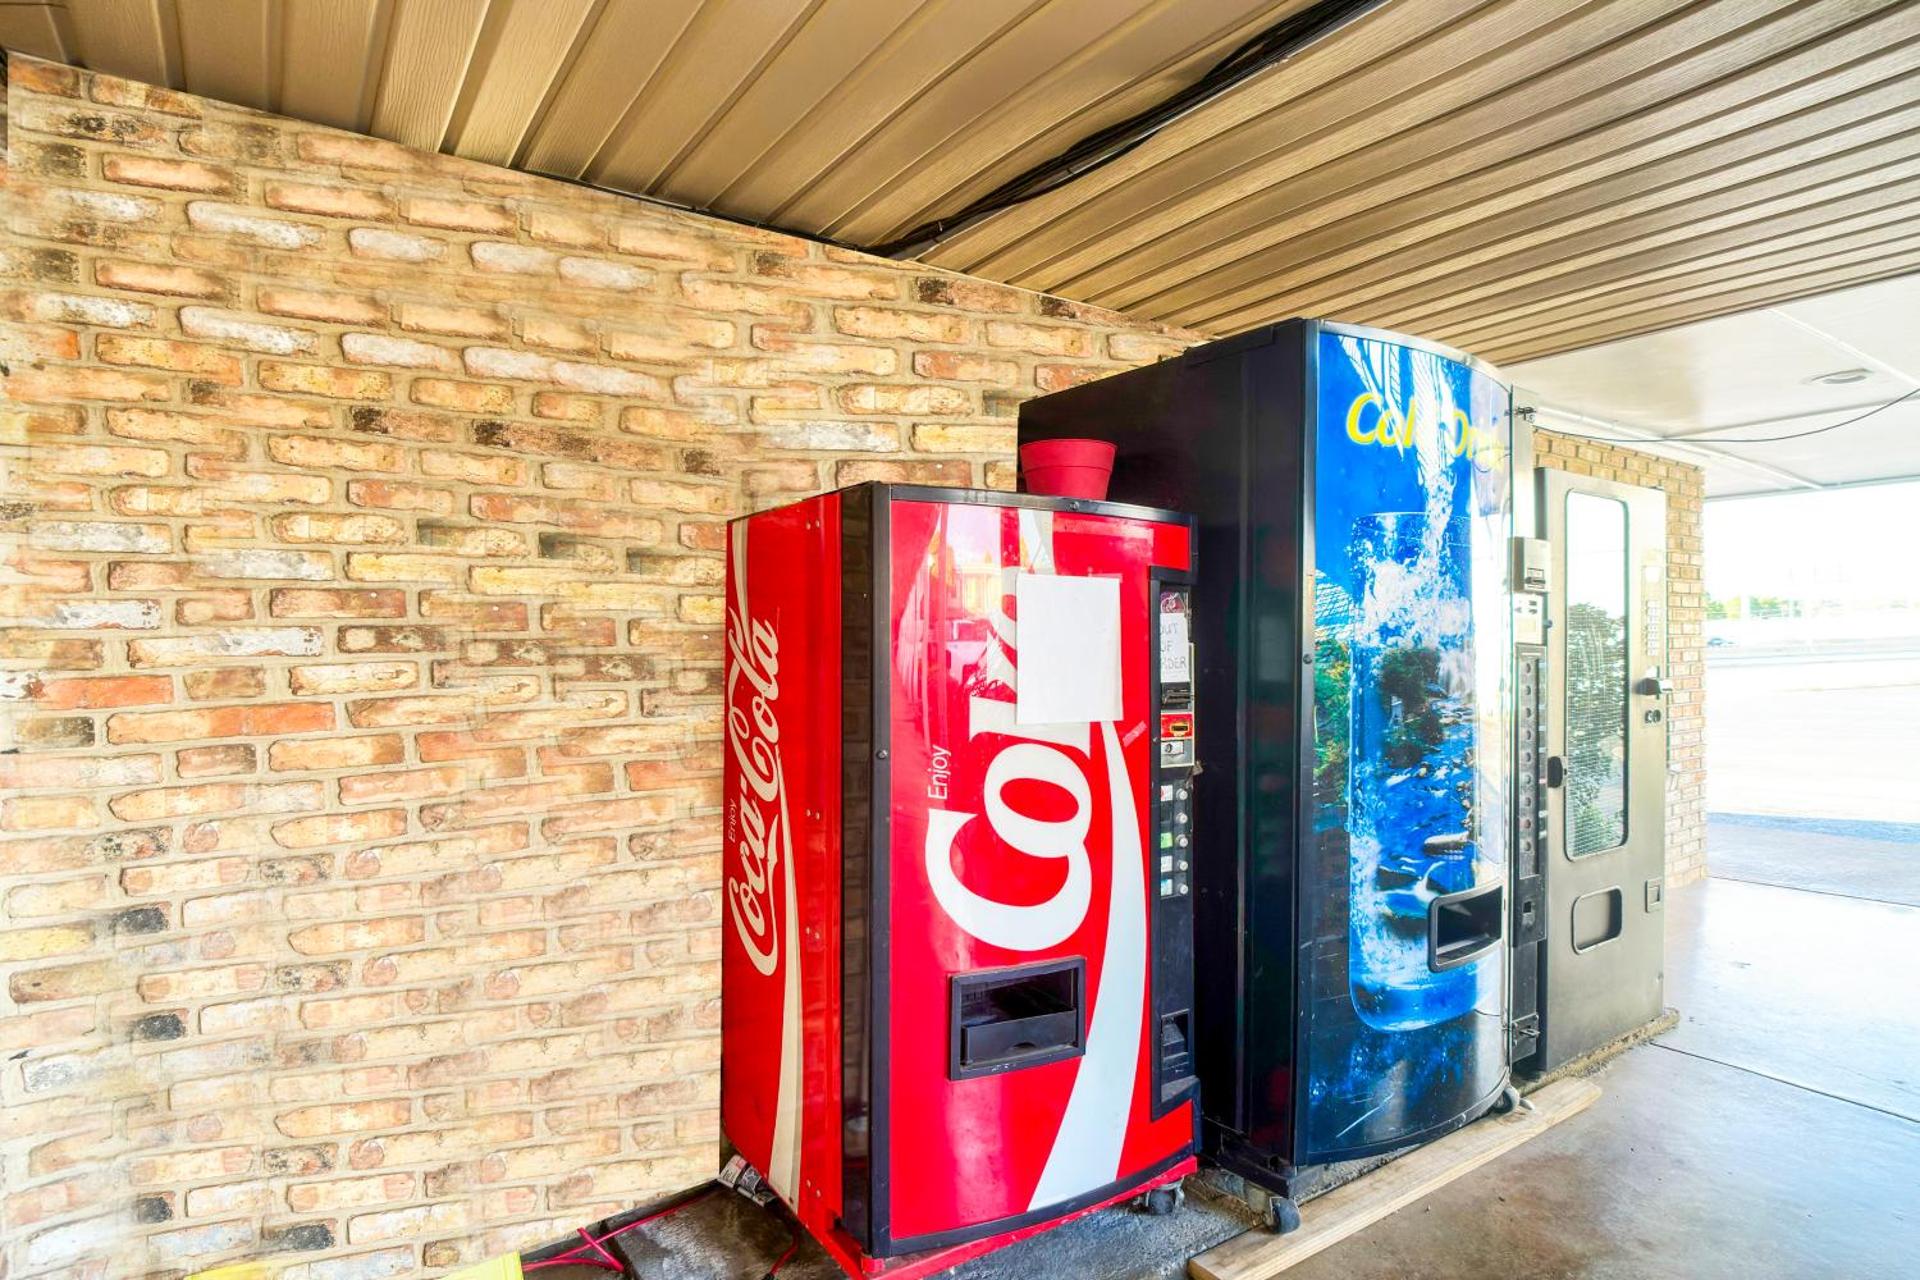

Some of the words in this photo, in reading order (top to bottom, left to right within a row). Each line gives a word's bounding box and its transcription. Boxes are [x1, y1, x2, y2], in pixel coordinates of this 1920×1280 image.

[727, 606, 780, 977] Coca-Cola
[927, 744, 951, 800] Enjoy
[728, 798, 737, 843] Enjoy
